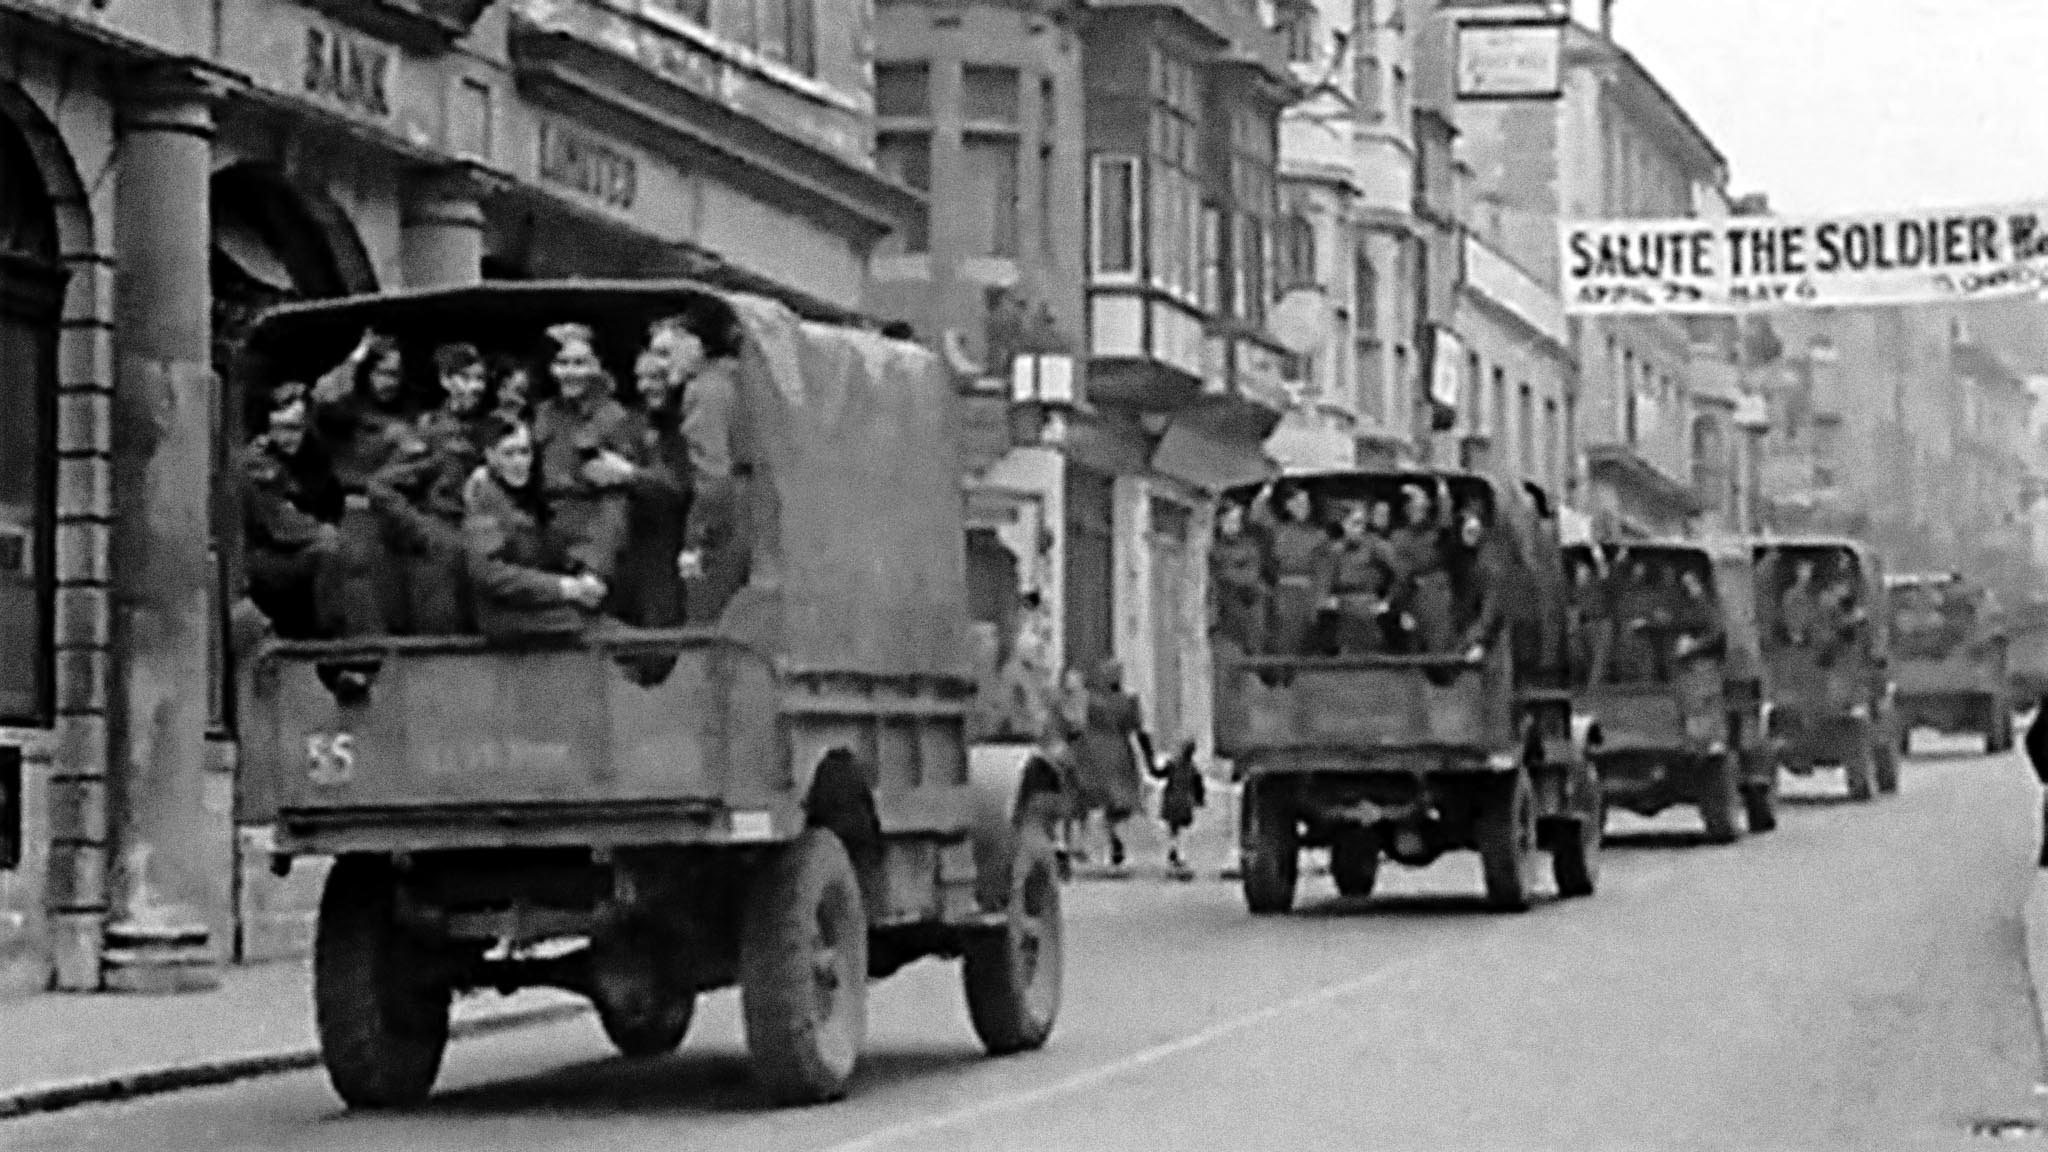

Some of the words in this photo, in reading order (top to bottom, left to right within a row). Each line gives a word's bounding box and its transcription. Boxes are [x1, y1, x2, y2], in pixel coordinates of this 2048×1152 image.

[303, 26, 390, 118] BANK
[1568, 229, 1714, 278] SALUTE
[1726, 226, 1805, 276] THE
[1815, 214, 1998, 272] SOLDIER
